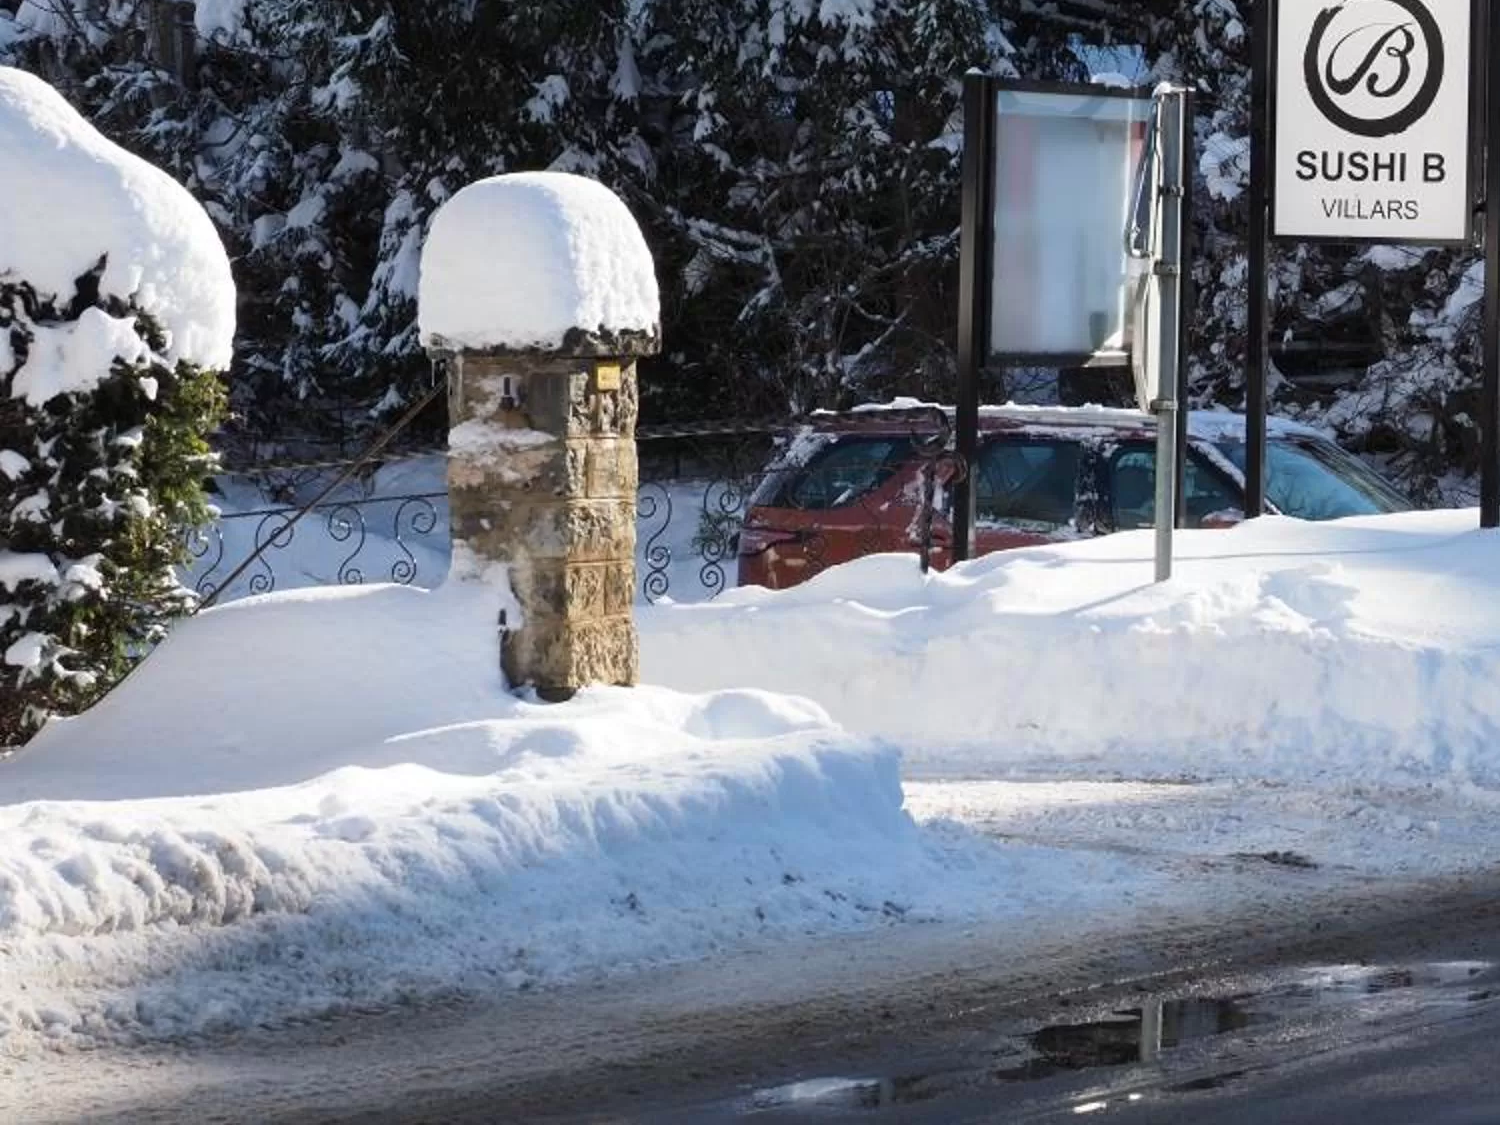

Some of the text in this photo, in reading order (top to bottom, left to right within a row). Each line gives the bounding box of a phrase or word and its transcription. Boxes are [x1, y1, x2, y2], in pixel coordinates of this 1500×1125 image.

[1295, 150, 1446, 183] SUSHI B
[1321, 198, 1419, 220] VILLARS
